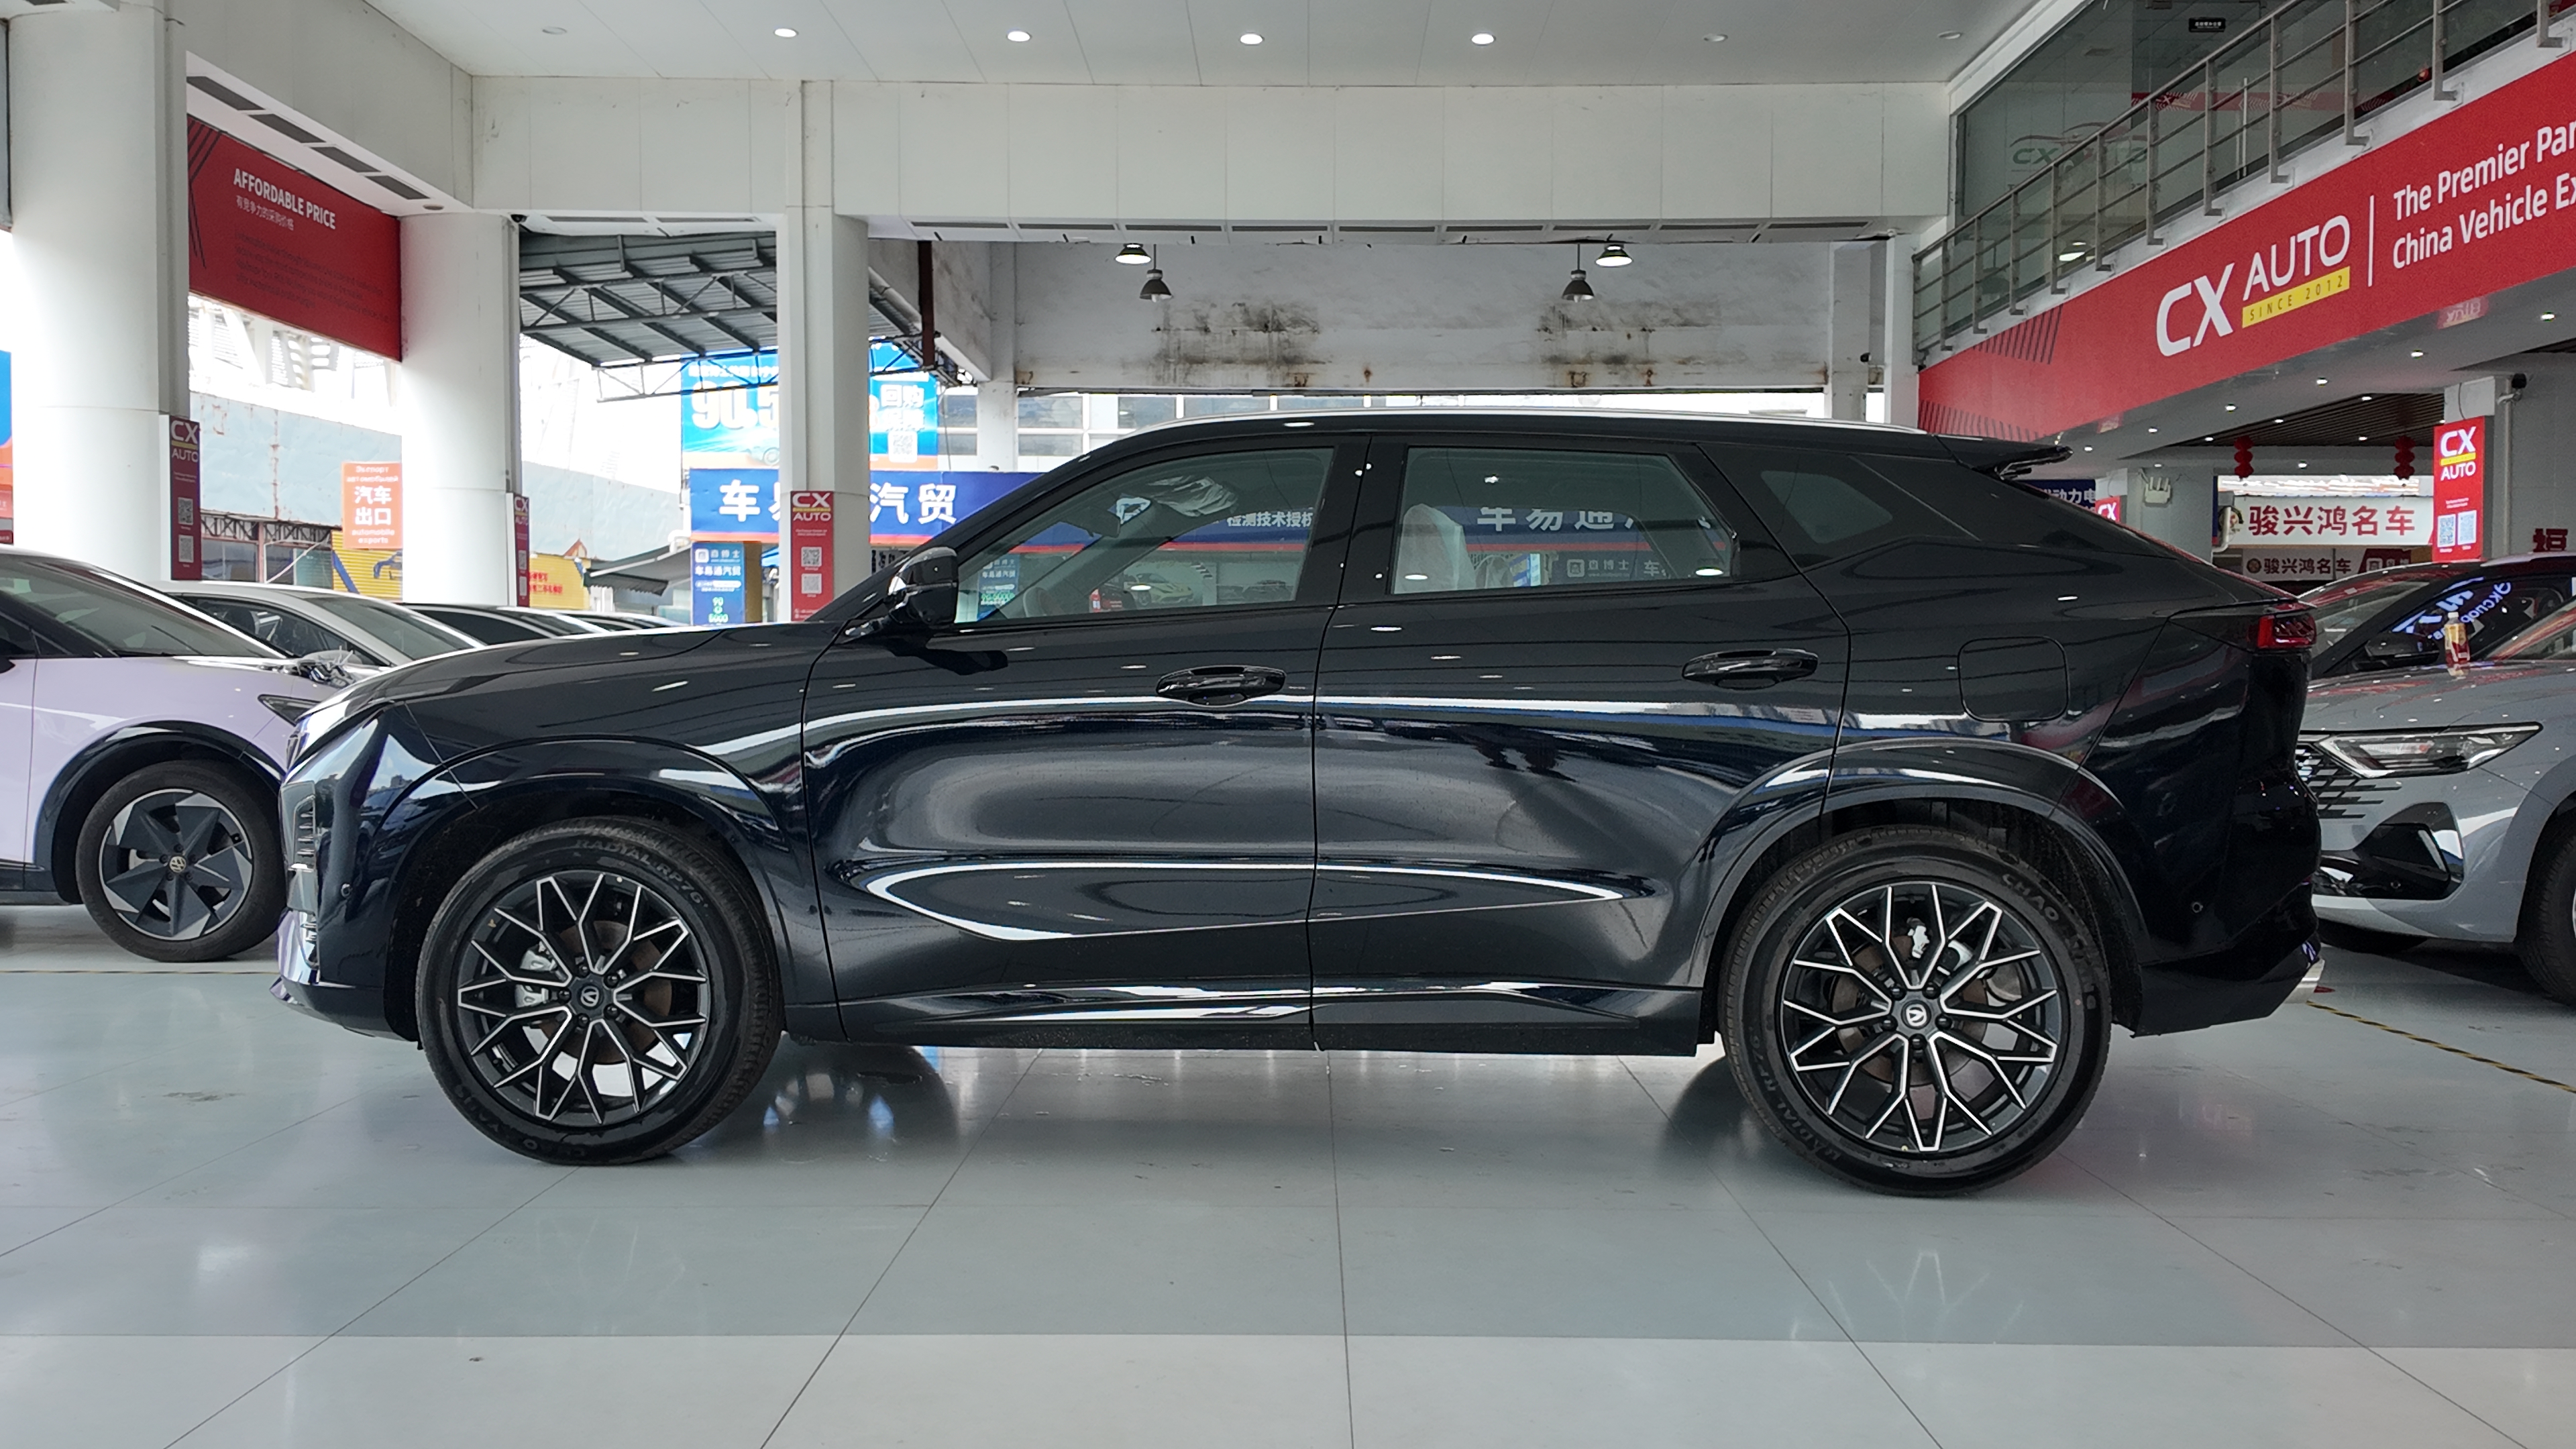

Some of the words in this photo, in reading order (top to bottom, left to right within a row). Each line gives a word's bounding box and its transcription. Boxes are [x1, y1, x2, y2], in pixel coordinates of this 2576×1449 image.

[2393, 184, 2431, 221] The
[2438, 140, 2530, 204] Premier
[2536, 120, 2576, 163] Par
[233, 168, 304, 215] AFFORDABLE
[306, 201, 336, 229] PRICE
[2393, 226, 2453, 268] China
[2459, 184, 2548, 244] Vehicle
[2156, 262, 2235, 357] CX
[2243, 215, 2350, 301] AUTO
[2250, 294, 2292, 321] SINCE
[2306, 275, 2343, 300] 2012
[171, 420, 199, 444] CX
[2440, 426, 2477, 458] CX
[172, 448, 199, 463] AUTO
[2440, 462, 2476, 481] AUTO
[354, 485, 392, 504] 汽车
[514, 497, 529, 512] CX
[792, 492, 830, 508] CX
[2044, 488, 2096, 503] 动力电
[355, 506, 392, 526] 出口
[792, 513, 831, 521] AUTO
[2248, 505, 2415, 536] 骏兴鸿名车
[2263, 558, 2351, 574] 骏兴鸿名车
[574, 839, 651, 865] RADIAL
